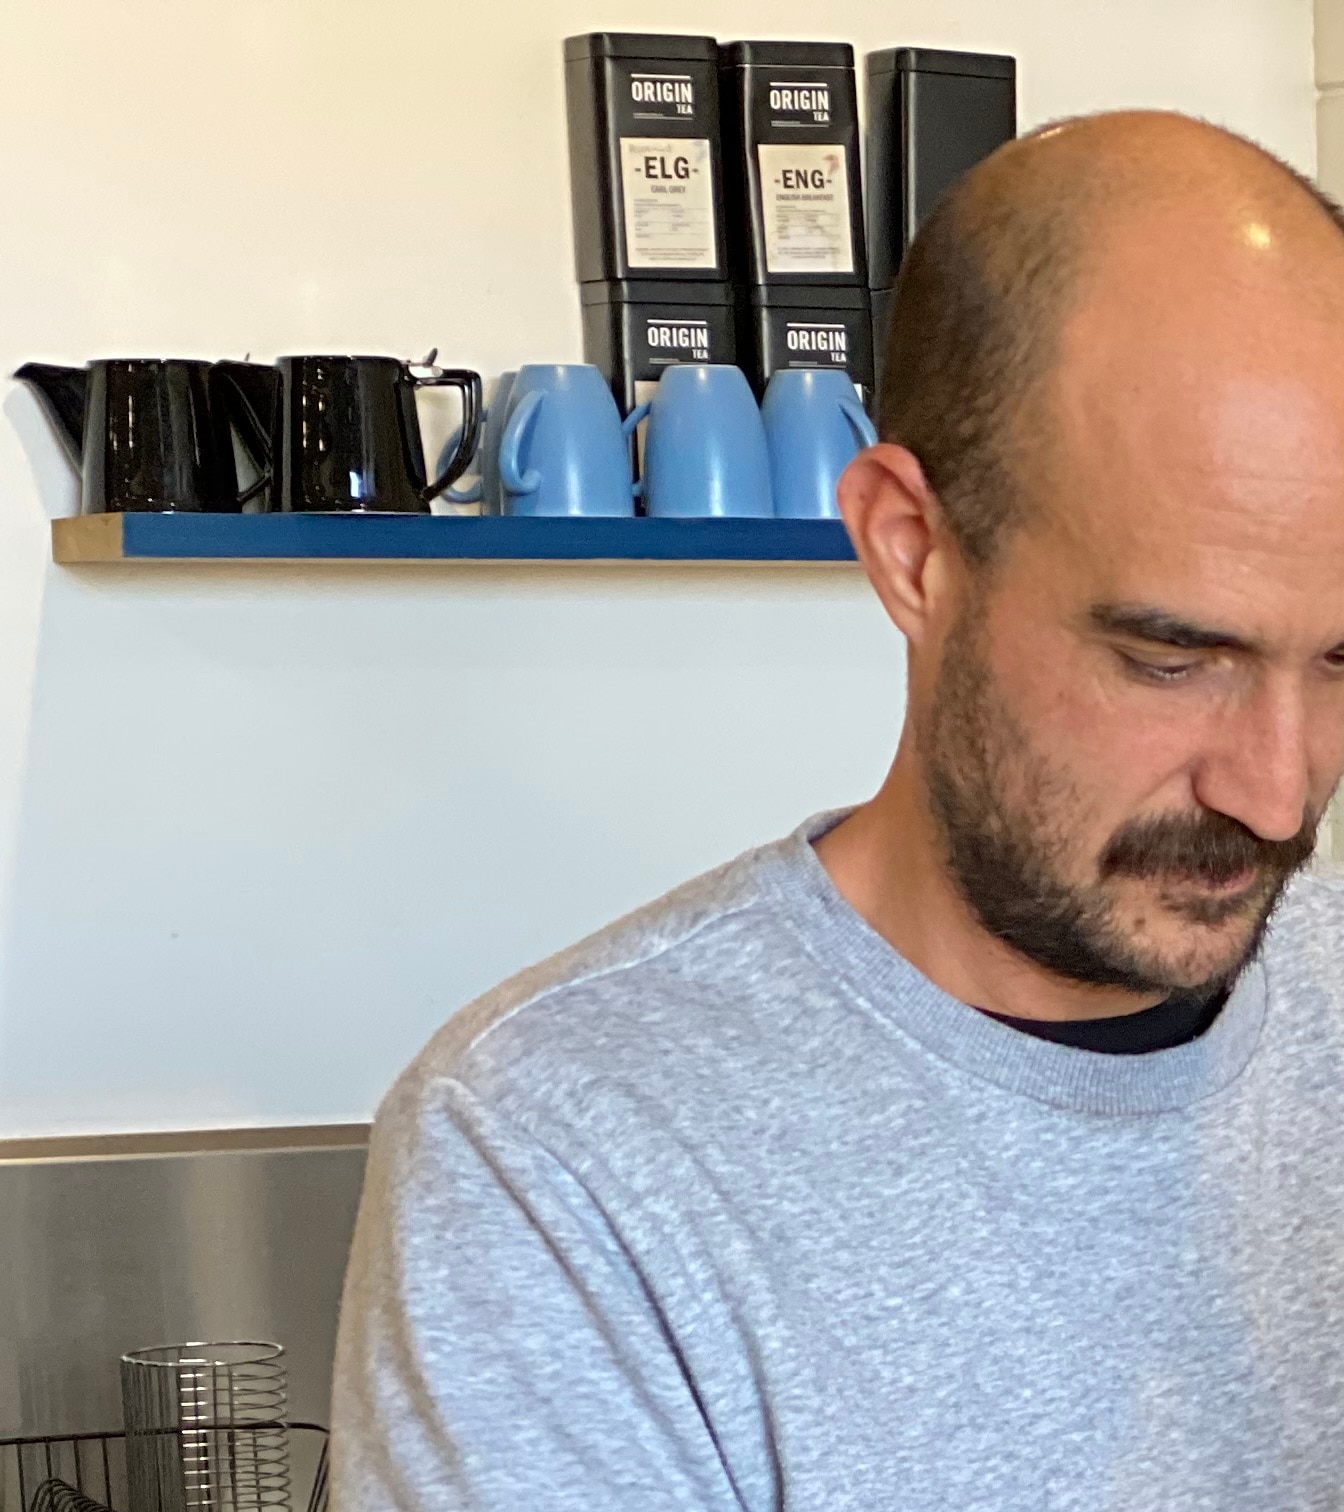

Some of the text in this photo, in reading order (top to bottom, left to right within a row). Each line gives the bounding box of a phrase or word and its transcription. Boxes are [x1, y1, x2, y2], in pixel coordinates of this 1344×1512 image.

[631, 81, 693, 103] ORIGIN
[769, 89, 830, 111] ORIGIN
[677, 104, 693, 114] TEA
[813, 111, 830, 122] TEA
[647, 327, 708, 348] ORIGIN
[786, 330, 847, 351] ORIGIN
[692, 349, 709, 360] TEA
[830, 352, 847, 363] TEA
